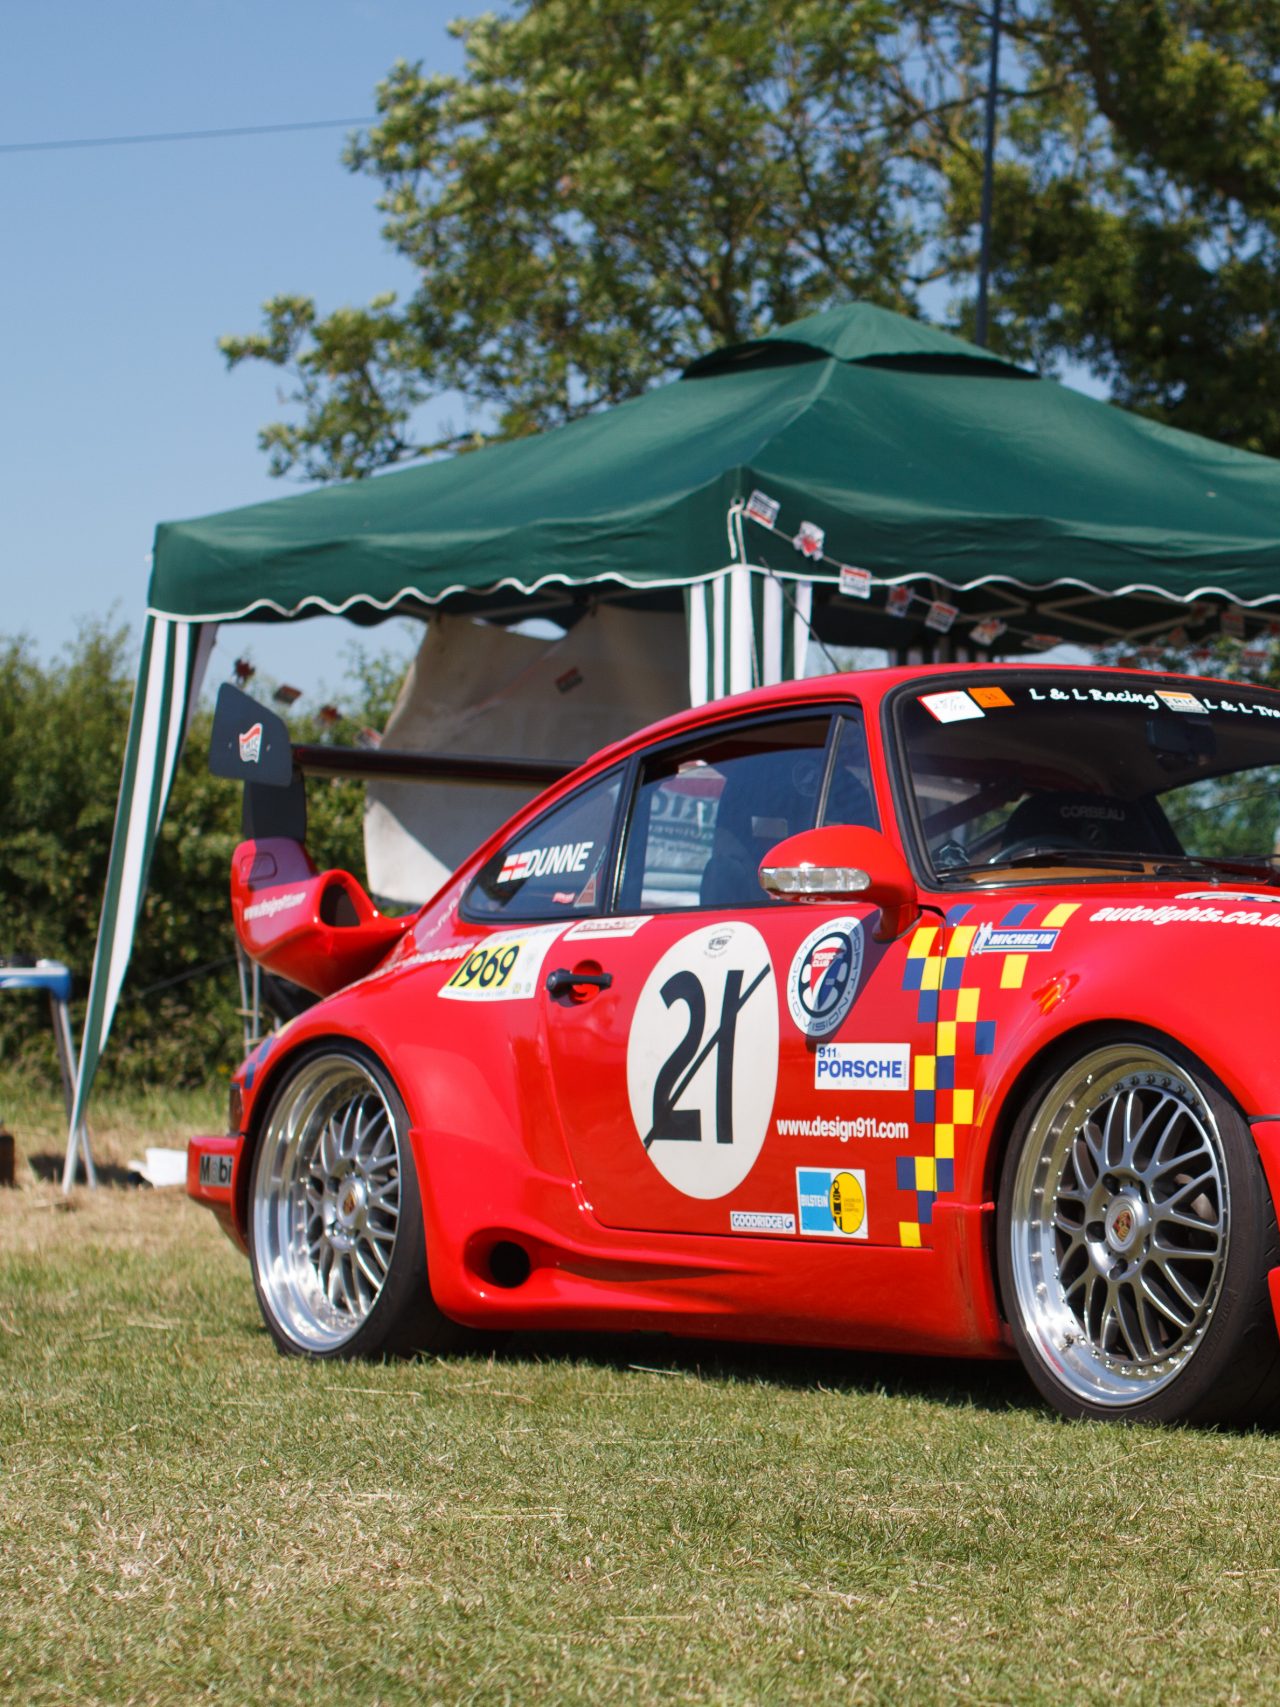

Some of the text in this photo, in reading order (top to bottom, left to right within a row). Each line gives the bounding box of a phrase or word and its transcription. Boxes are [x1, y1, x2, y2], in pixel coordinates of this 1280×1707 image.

[1029, 688, 1046, 701] L
[1050, 688, 1069, 700] &
[1072, 688, 1088, 701] L
[1089, 689, 1159, 710] Racing
[1203, 698, 1218, 710] L
[1220, 700, 1238, 712] &
[1239, 702, 1253, 715] L
[523, 841, 594, 877] DUNNE
[988, 933, 1055, 946] MICHELIN
[449, 944, 520, 988] 1969
[791, 997, 849, 1032] DIVISION
[650, 968, 752, 1146] 21
[817, 1060, 902, 1078] PORSCHE
[777, 1115, 909, 1143] www.design911.com
[732, 1213, 784, 1229] GOODRIDGE
